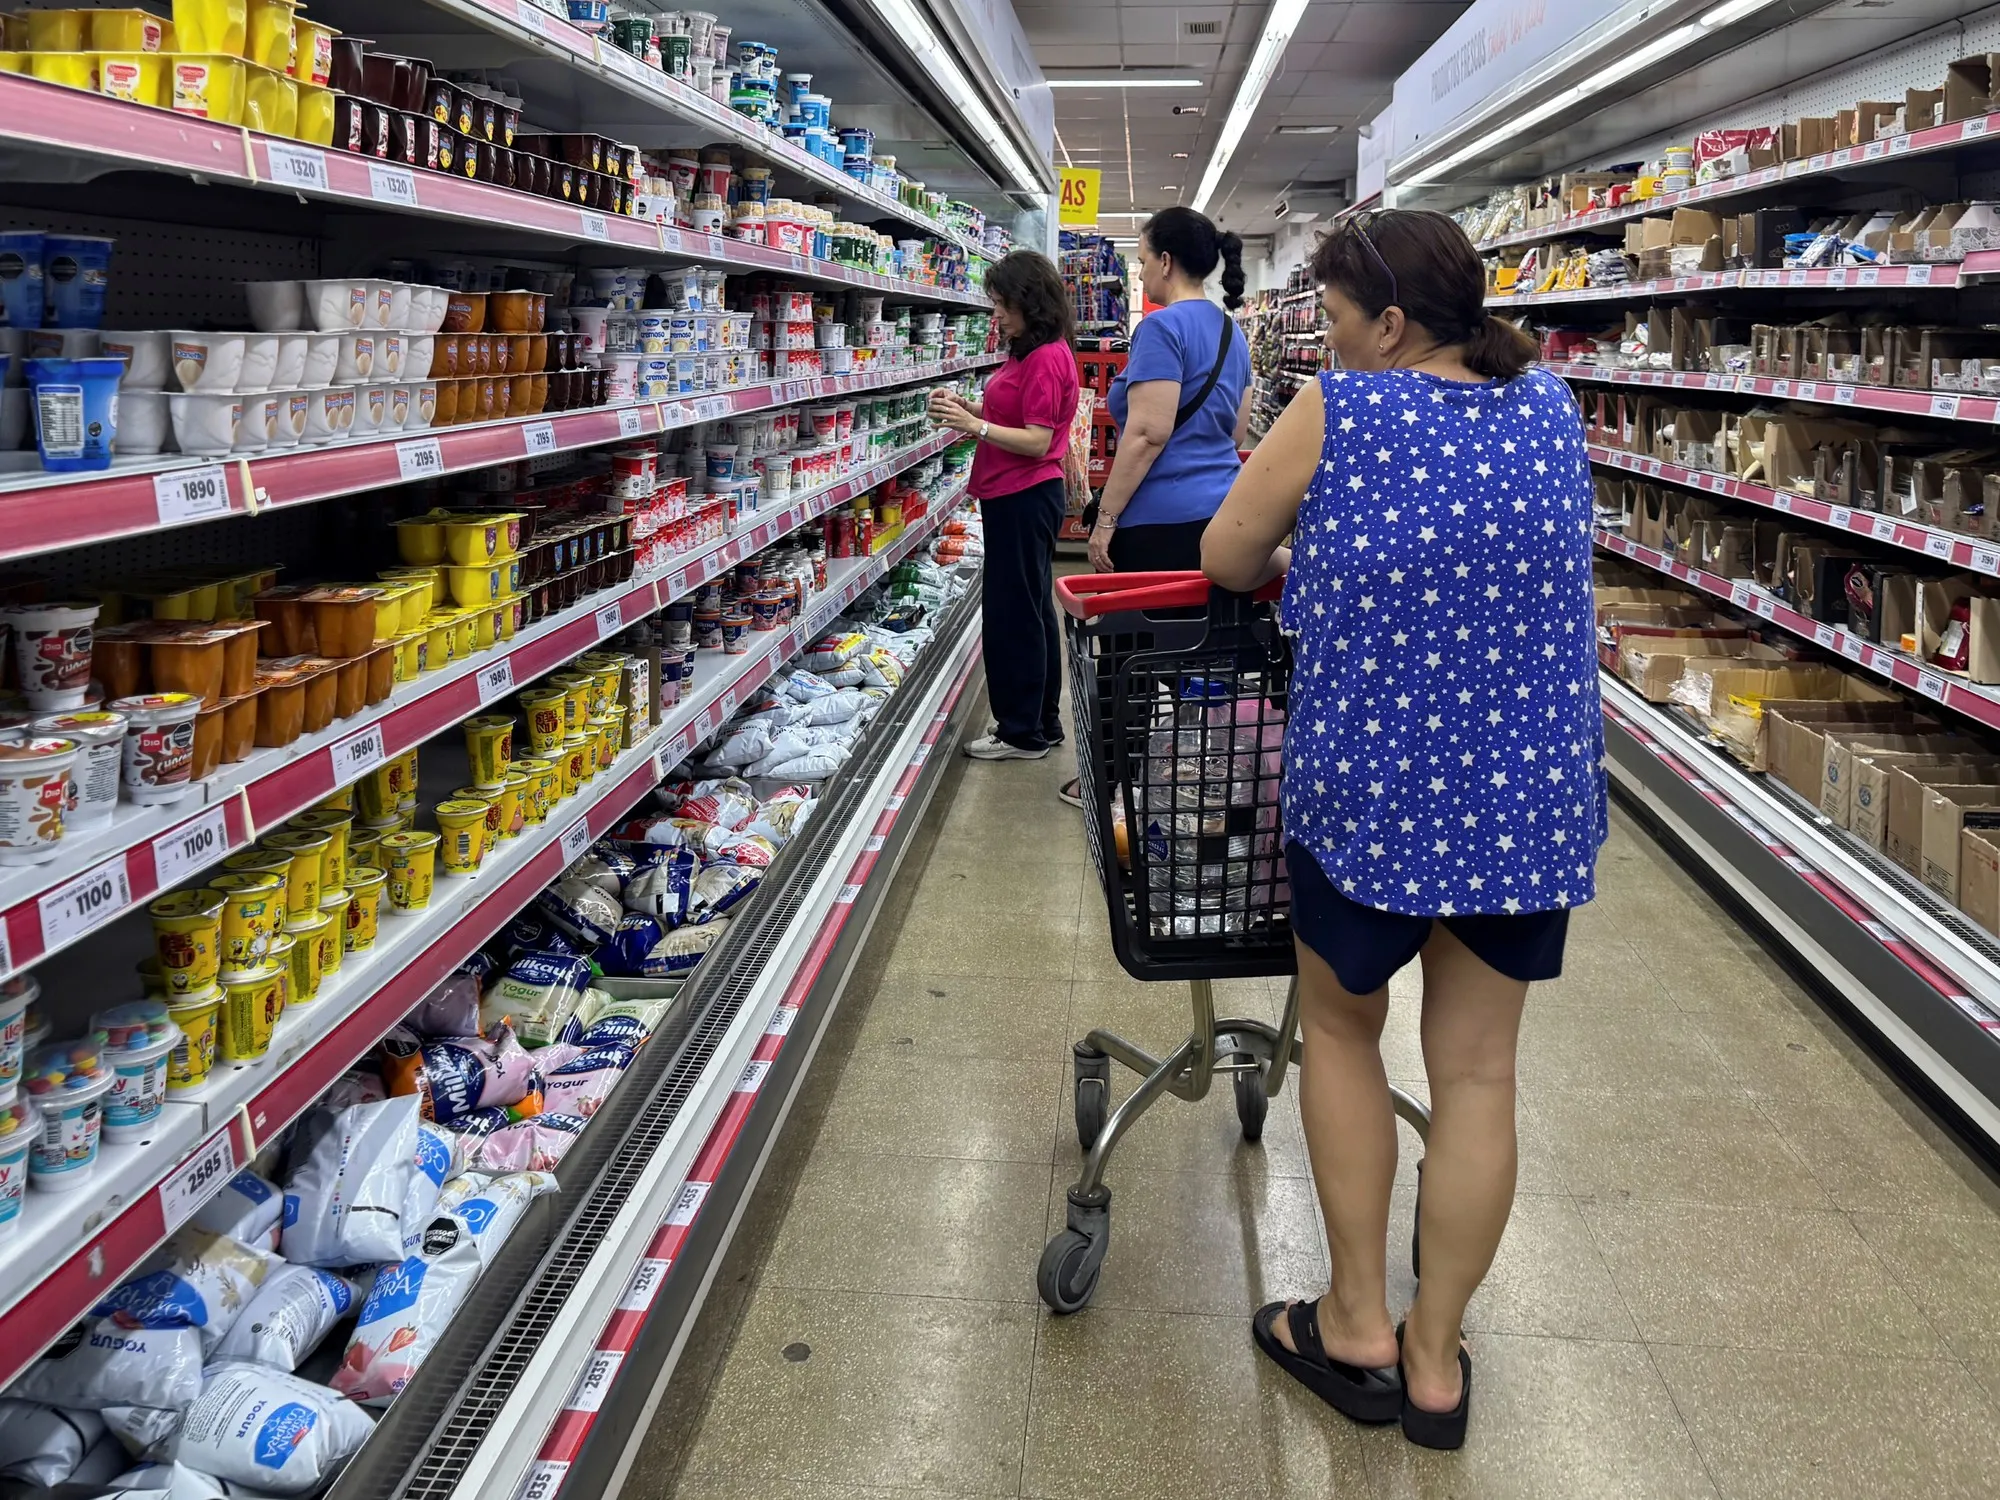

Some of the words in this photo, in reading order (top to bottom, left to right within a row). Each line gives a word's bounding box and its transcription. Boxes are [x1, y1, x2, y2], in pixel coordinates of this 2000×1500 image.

[290, 158, 316, 178] 1320
[387, 177, 408, 195] 1320
[1060, 179, 1086, 206] AS
[415, 451, 434, 467] 2195
[183, 478, 215, 501] 1890
[490, 668, 507, 687] 1980
[351, 739, 374, 761] 1980
[183, 827, 214, 859] 1100
[76, 879, 113, 916] 1100
[502, 981, 542, 997] Yogur
[547, 1078, 589, 1091] Yogur
[188, 1151, 222, 1194] 2585
[678, 1188, 699, 1209] 3455
[633, 1266, 657, 1291] 3245
[90, 1334, 146, 1353] YOGUR
[584, 1359, 609, 1389] 2835
[236, 1400, 268, 1439] YOGUR
[526, 1473, 552, 1500] 835
